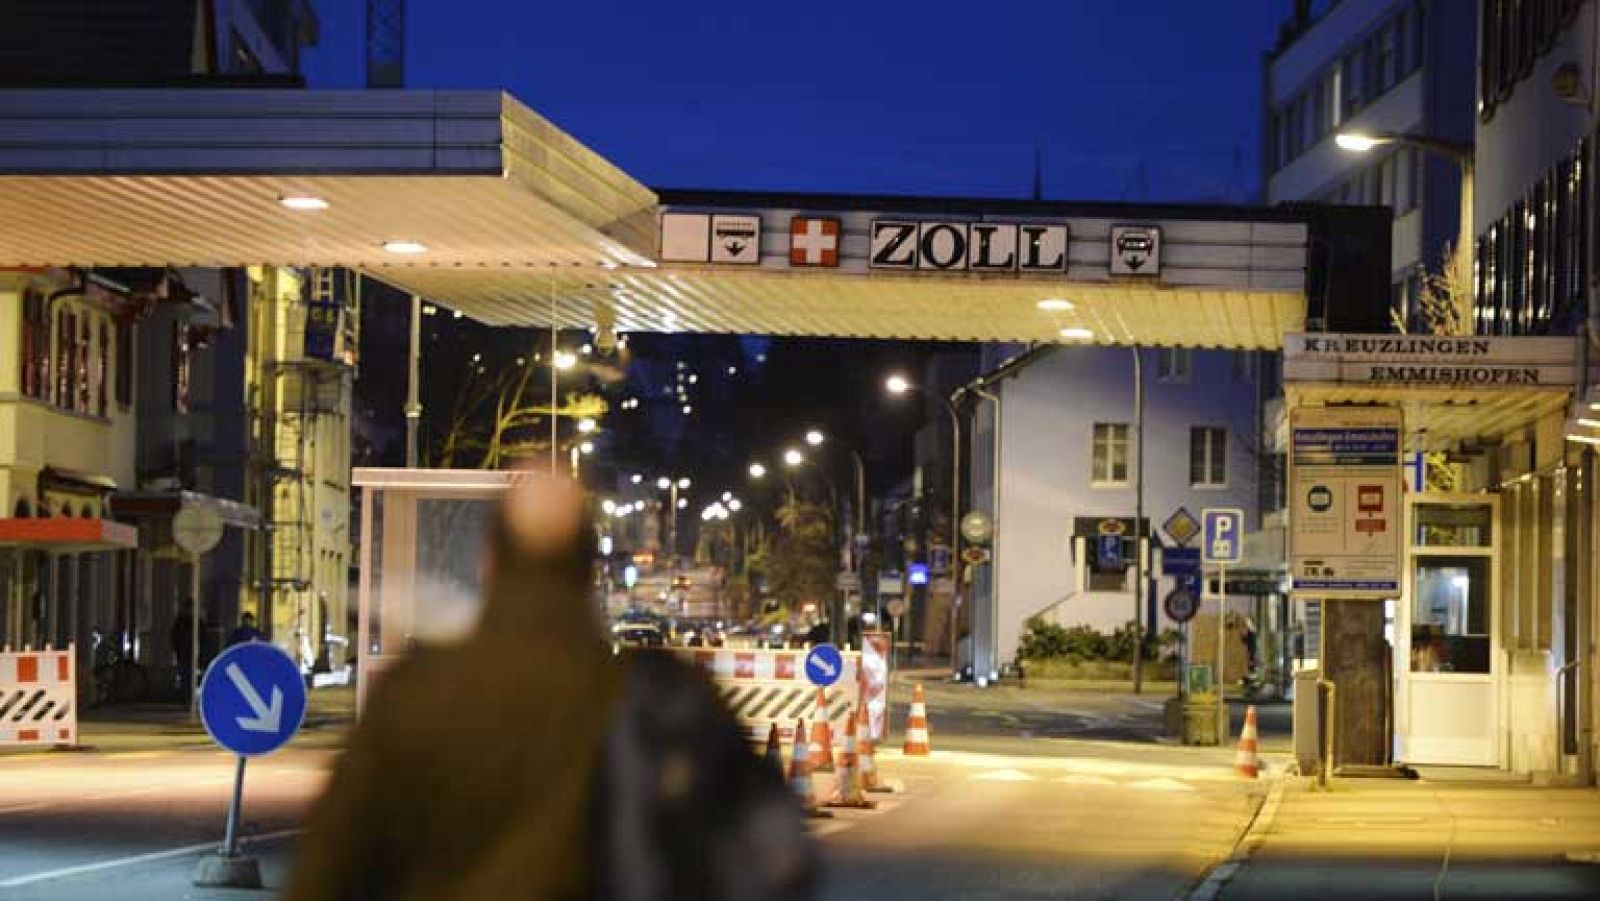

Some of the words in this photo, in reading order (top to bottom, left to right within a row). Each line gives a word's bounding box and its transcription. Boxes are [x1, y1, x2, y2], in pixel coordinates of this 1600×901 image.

[873, 222, 1064, 268] ZOLL
[1304, 338, 1489, 355] KREUZLINGEN
[1369, 366, 1540, 384] EMMISHOFEN
[1216, 516, 1231, 540] P
